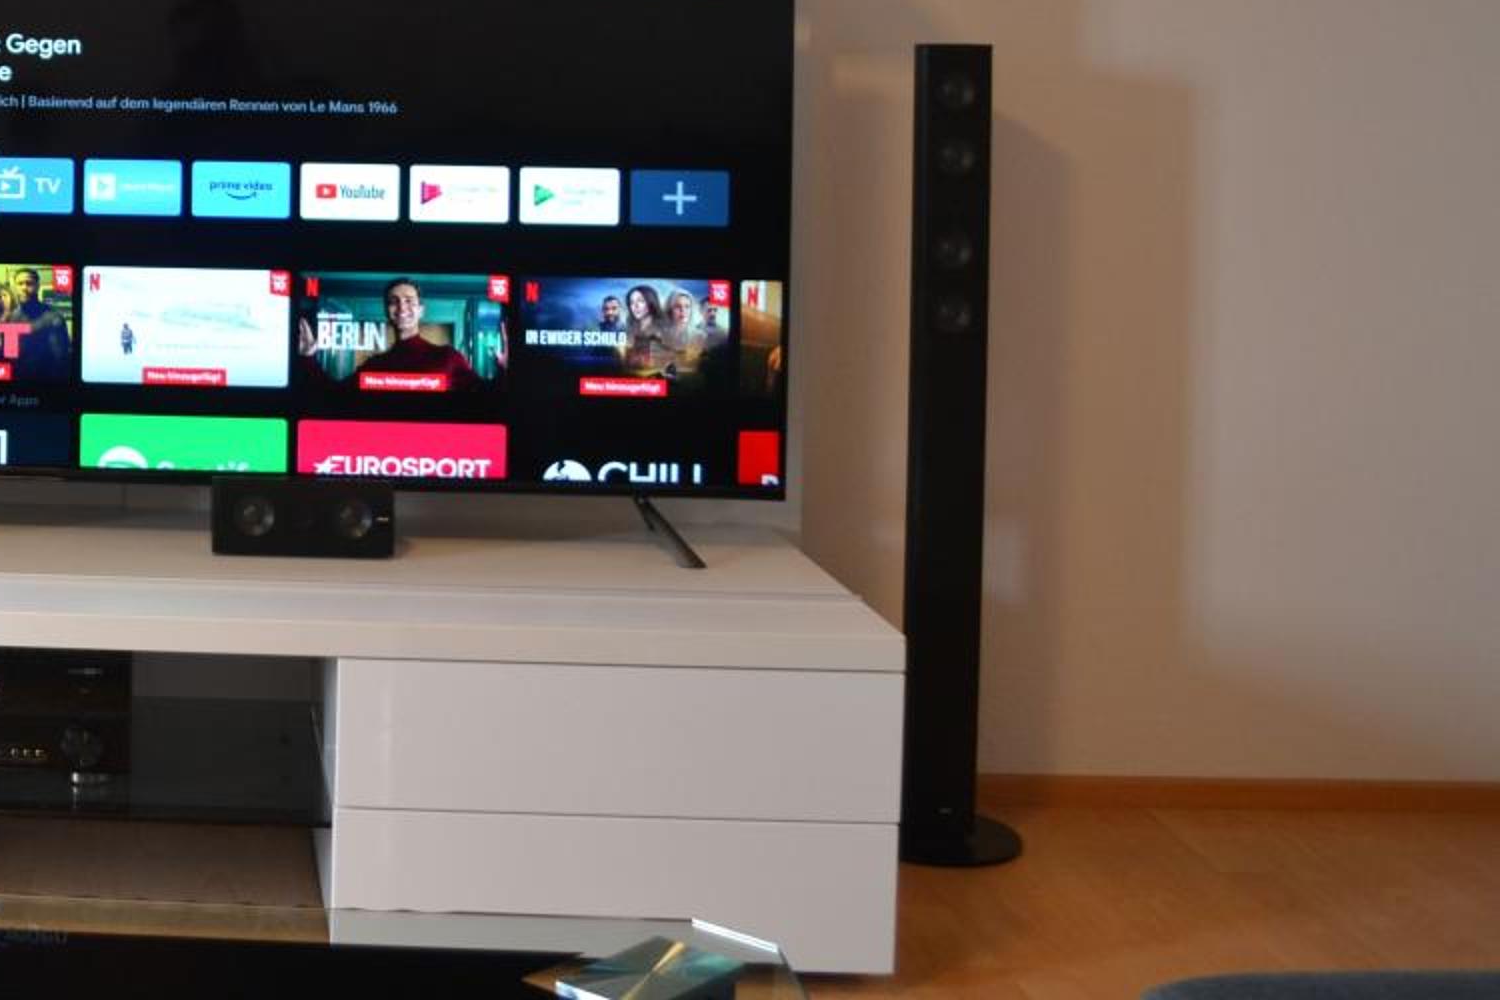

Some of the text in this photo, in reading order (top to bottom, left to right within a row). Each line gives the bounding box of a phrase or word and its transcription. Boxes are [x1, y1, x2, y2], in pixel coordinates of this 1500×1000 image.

[5, 33, 82, 60] Gegen
[28, 95, 93, 109] Basierend
[95, 96, 118, 109] auf
[121, 97, 149, 110] dem
[153, 97, 226, 113] legendären
[229, 99, 279, 112] Rennen
[281, 102, 307, 112] von
[309, 100, 326, 113] Le
[329, 100, 365, 114] Mans
[368, 100, 398, 114] 1966
[34, 177, 62, 194] TV
[209, 180, 274, 192] prime video
[339, 184, 386, 200] YouTube
[317, 321, 387, 351] BERLIN
[540, 330, 582, 345] EWIGER
[584, 330, 627, 347] SCHULD
[329, 456, 492, 479] EUROSPORT
